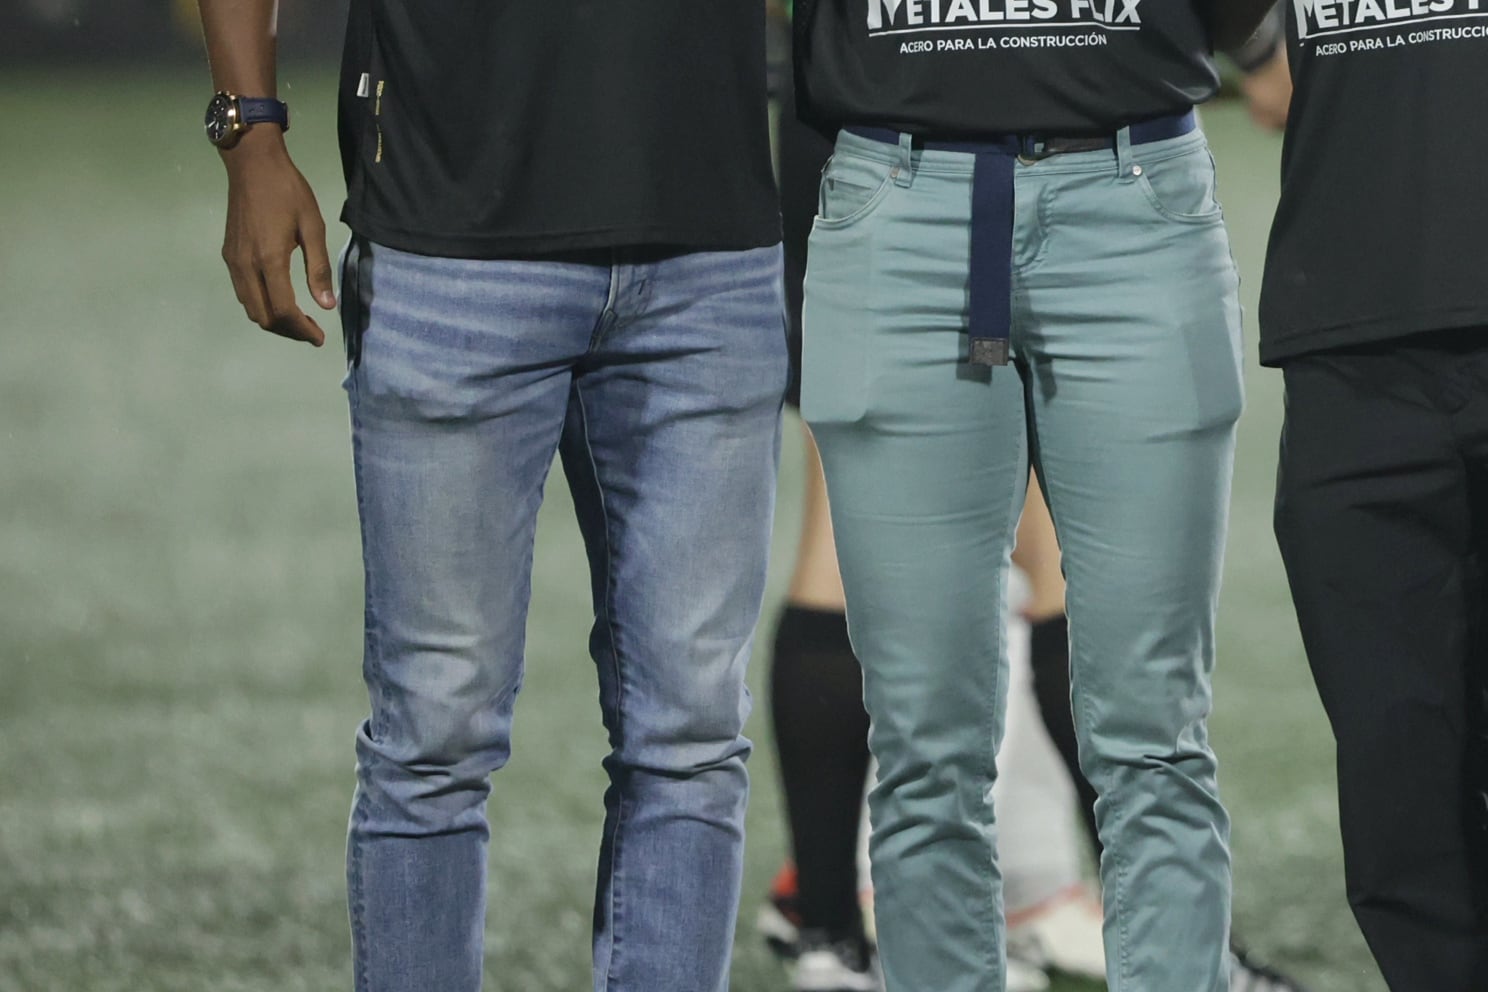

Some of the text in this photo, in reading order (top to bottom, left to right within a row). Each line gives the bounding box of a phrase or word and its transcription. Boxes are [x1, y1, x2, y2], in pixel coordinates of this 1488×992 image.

[900, 31, 1107, 54] ACERO PARA LA CONSTRUCCIÓN
[1315, 42, 1347, 56] ACERO
[1350, 38, 1384, 52] PARA
[1387, 35, 1405, 47] LA
